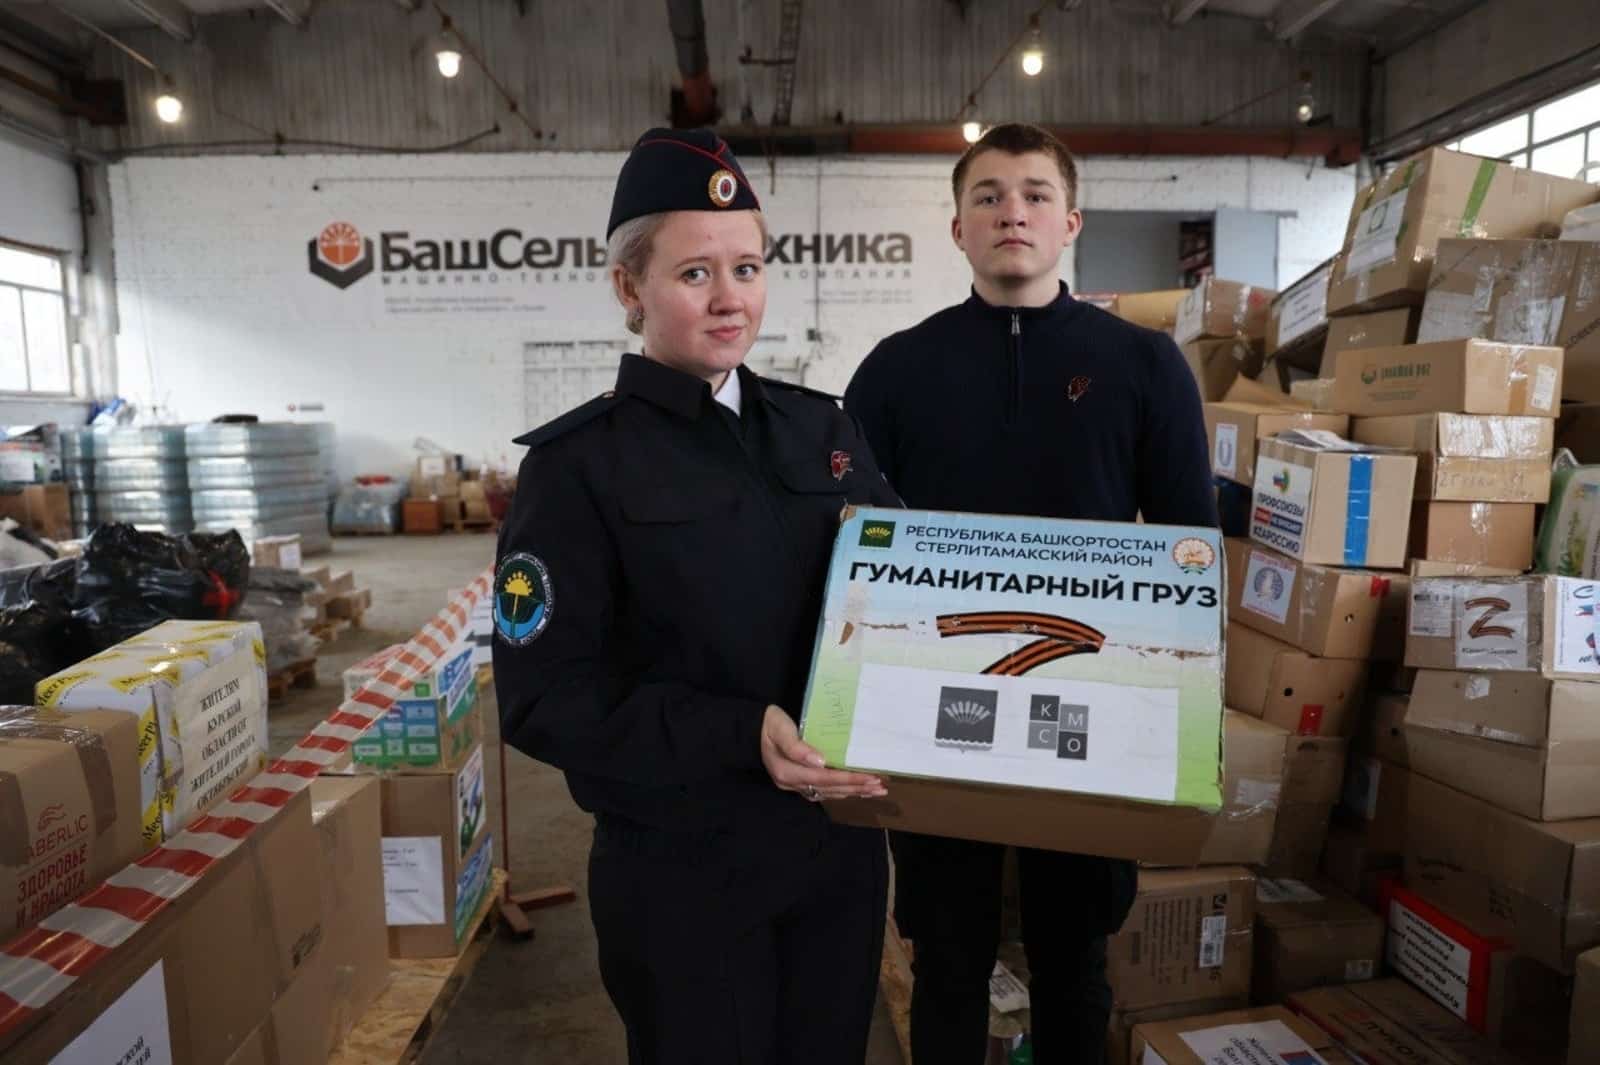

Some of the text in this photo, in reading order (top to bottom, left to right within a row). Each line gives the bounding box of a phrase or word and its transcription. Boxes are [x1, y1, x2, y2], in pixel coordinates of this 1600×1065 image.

[906, 525, 1166, 552] РЕСПУБЛИКА БАШКОРТОСТАН
[915, 541, 1153, 567] СТЕРЛИТАМАКСКИЙ РАЙОН
[850, 562, 1218, 608] ГУМАНИТАРНЫЙ ГРУЗ
[17, 842, 88, 903] ЗДОРОВЬЕ
